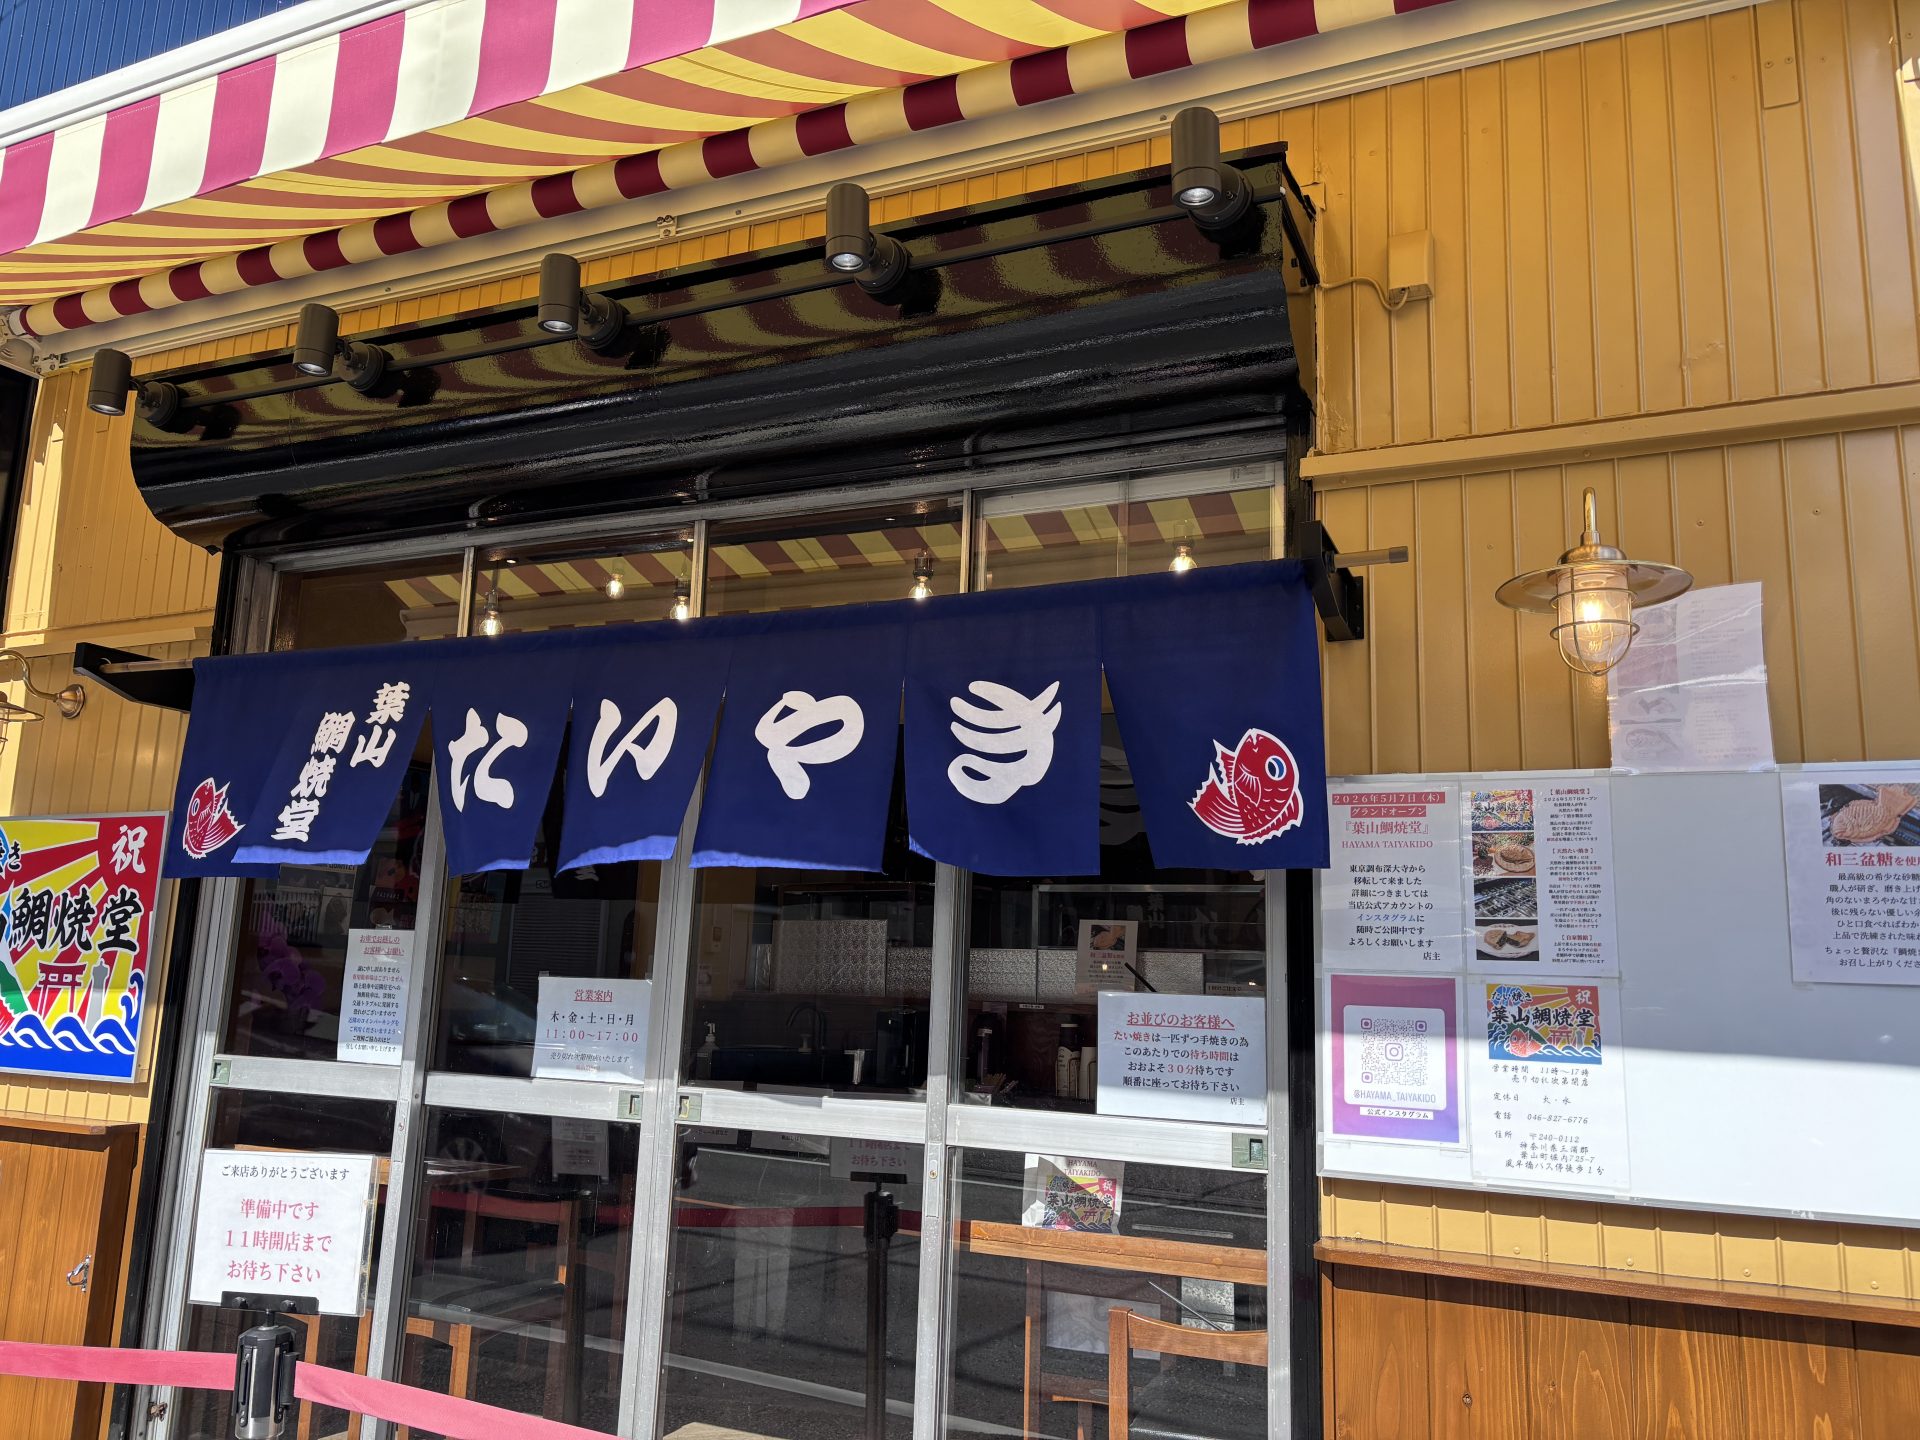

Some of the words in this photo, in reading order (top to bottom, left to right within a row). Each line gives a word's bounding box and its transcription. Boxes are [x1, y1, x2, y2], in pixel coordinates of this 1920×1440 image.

[350, 681, 411, 768] 葉山
[271, 711, 356, 843] 鯛焼堂
[1351, 807, 1426, 817] グランドオープン
[1345, 821, 1430, 835] 『葉山鯛焼堂』
[109, 824, 148, 875] 祝
[1342, 841, 1380, 849] HAYAMA
[1382, 841, 1433, 849] TAIYAKIDO
[1349, 864, 1426, 874] 東京調布深大寺から
[1353, 876, 1422, 886] 移転して来ました
[1351, 889, 1428, 898] 詳細につきましては
[1348, 901, 1434, 910] 当店公式アカウントの
[1825, 896, 1920, 905] 角のないまろやかな甘
[0, 886, 143, 953] 鯛焼堂
[1356, 914, 1425, 923] インスタグラムに
[1356, 925, 1425, 935] 随時ご公開中です
[1348, 938, 1434, 947] よろしくお願いします
[1422, 951, 1441, 961] 店主
[574, 989, 613, 1002] 営業案内
[1491, 991, 1532, 1003] たい焼き
[1575, 989, 1592, 1005] 祝
[550, 1010, 634, 1026] 木・金・土・日・月
[1126, 1012, 1236, 1030] お並びのお客様へ
[1491, 1006, 1596, 1028] 葉山鯛焼堂
[1114, 1031, 1249, 1048] たい焼きは一匹ずつ手焼きの為
[1124, 1047, 1239, 1062] このあたりでの待ち時間は
[1127, 1061, 1235, 1077] おおよそ30分待ちです
[1492, 1065, 1529, 1074] 営業時間
[1122, 1076, 1240, 1092] 順番に座ってお待ち下さい
[1230, 1097, 1245, 1106] 店主
[1353, 1090, 1437, 1104] @HAYAMA_TAIYAKIDO
[1493, 1092, 1520, 1102] 定休日
[1367, 1108, 1429, 1119] 公式インスタグラム
[1493, 1111, 1512, 1120] 電話
[1527, 1113, 1589, 1125] 046-827-6776
[1494, 1130, 1513, 1139] 住所
[1520, 1142, 1589, 1155] 神奈川県三浦郡
[1068, 1159, 1098, 1168] HAYAMA
[221, 1165, 350, 1181] ご来店ありがとうございます
[1103, 1179, 1113, 1192] 祝
[1047, 1191, 1114, 1210] 葉山鯛焼堂
[240, 1198, 320, 1221] 準備中です
[225, 1230, 332, 1253] 11時開店まで
[226, 1260, 322, 1283] お待ち下さい
